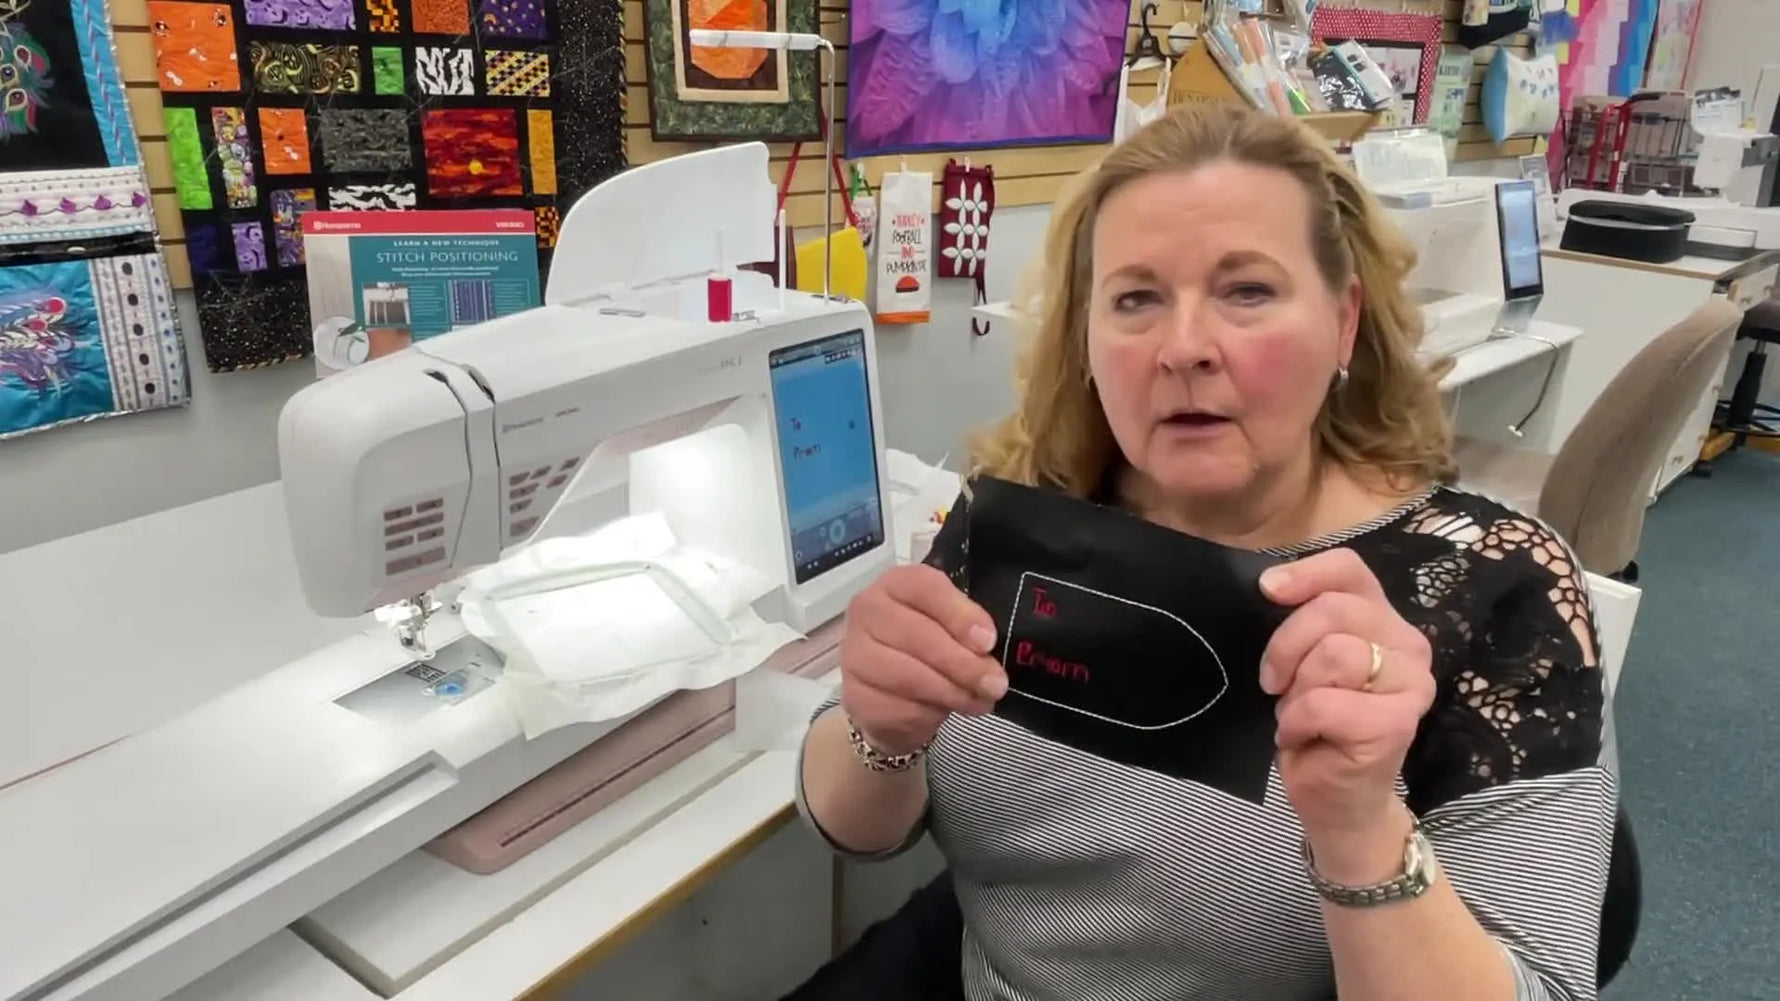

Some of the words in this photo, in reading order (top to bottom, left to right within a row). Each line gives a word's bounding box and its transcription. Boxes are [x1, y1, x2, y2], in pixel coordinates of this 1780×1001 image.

[453, 239, 499, 247] TECHNIQUE
[376, 252, 425, 263] STITCH
[430, 251, 519, 262] POSITIONING
[1033, 586, 1057, 618] To
